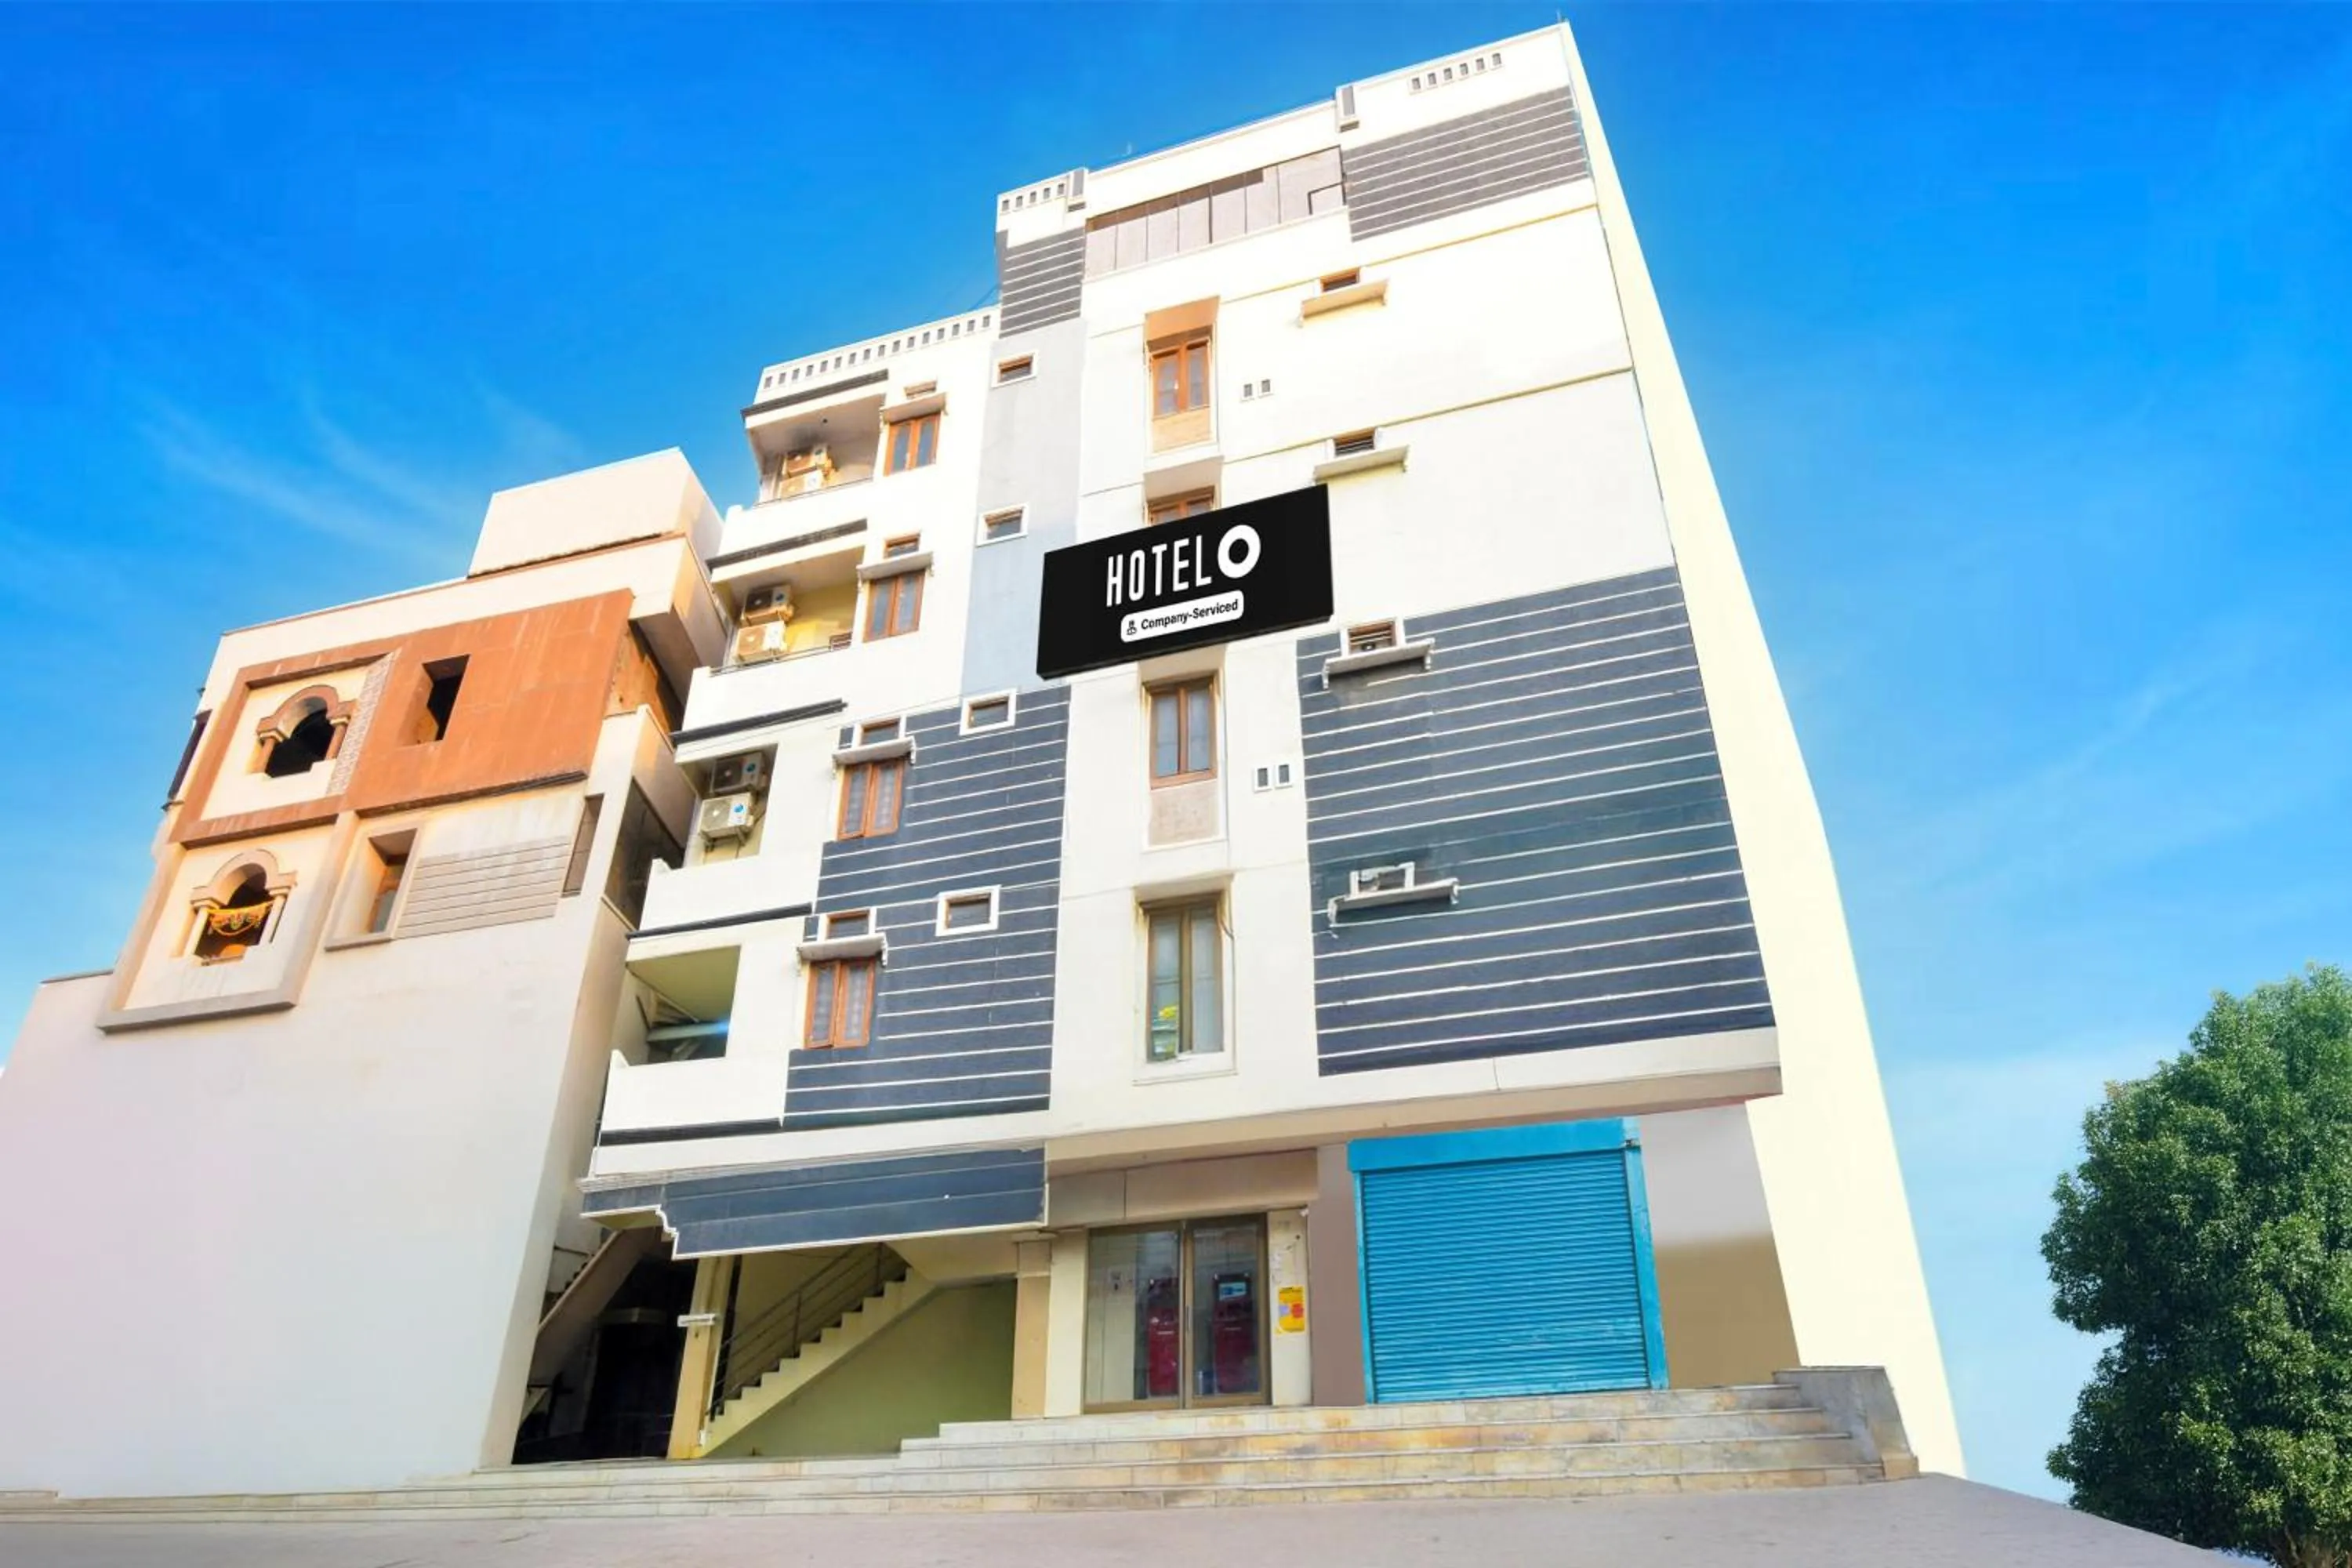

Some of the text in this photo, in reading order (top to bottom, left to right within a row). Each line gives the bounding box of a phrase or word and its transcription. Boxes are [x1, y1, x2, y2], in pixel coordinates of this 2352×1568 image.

[1106, 524, 1261, 608] HOTEL O
[1141, 599, 1238, 630] Company-Serviced
